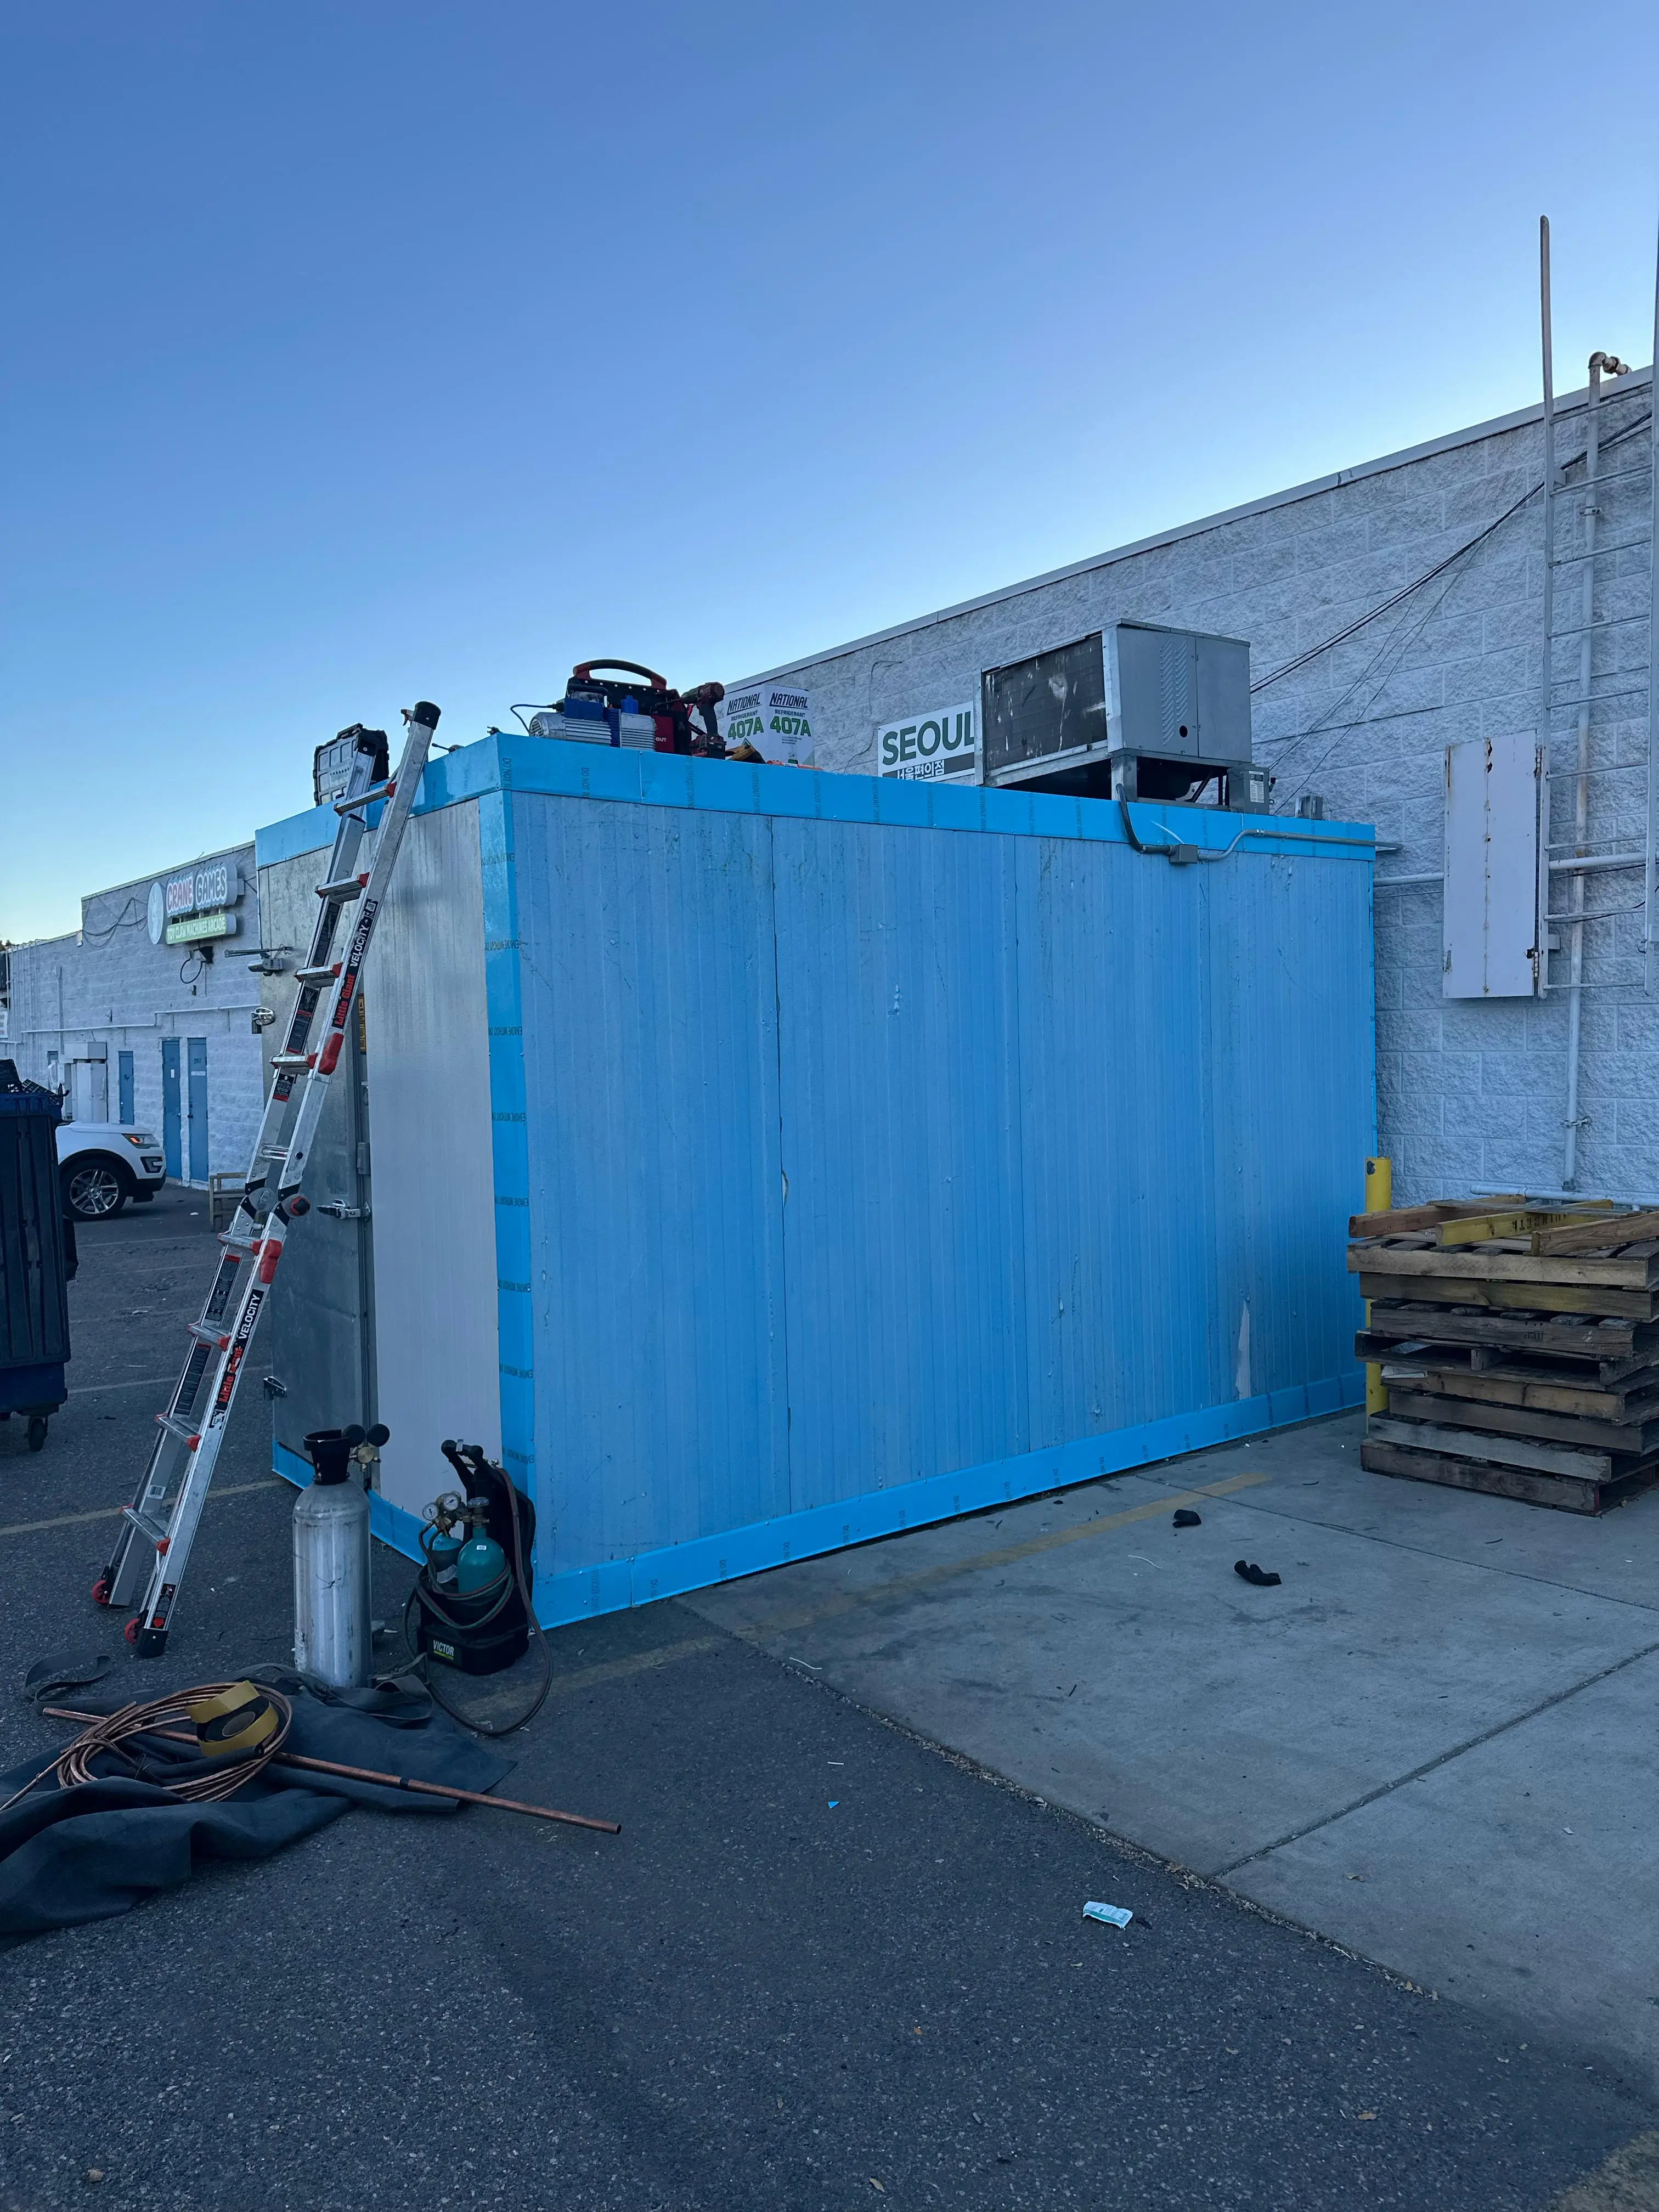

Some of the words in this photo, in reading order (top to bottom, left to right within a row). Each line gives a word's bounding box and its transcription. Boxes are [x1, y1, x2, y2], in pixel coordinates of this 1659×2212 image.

[727, 692, 761, 715] NATIONAL
[769, 692, 808, 709] NATIONAL
[731, 710, 758, 721] REFRIGERANT
[775, 709, 805, 718] REFRIGERANT
[727, 716, 764, 740] 407A
[770, 716, 811, 737] 407A
[882, 711, 974, 765] SEOUL
[503, 758, 511, 767] DO
[581, 768, 590, 776] DO
[503, 769, 511, 782] NOT
[166, 876, 194, 914] CRANE
[195, 866, 227, 906] GAMES
[187, 920, 207, 938] MACHINES
[207, 917, 225, 932] ARCADE
[334, 1001, 348, 1026] Little
[341, 974, 356, 999] Giant
[350, 924, 369, 967] VELOCITY
[238, 1294, 260, 1339] VELOCITY
[433, 1639, 454, 1656] VICTOR
